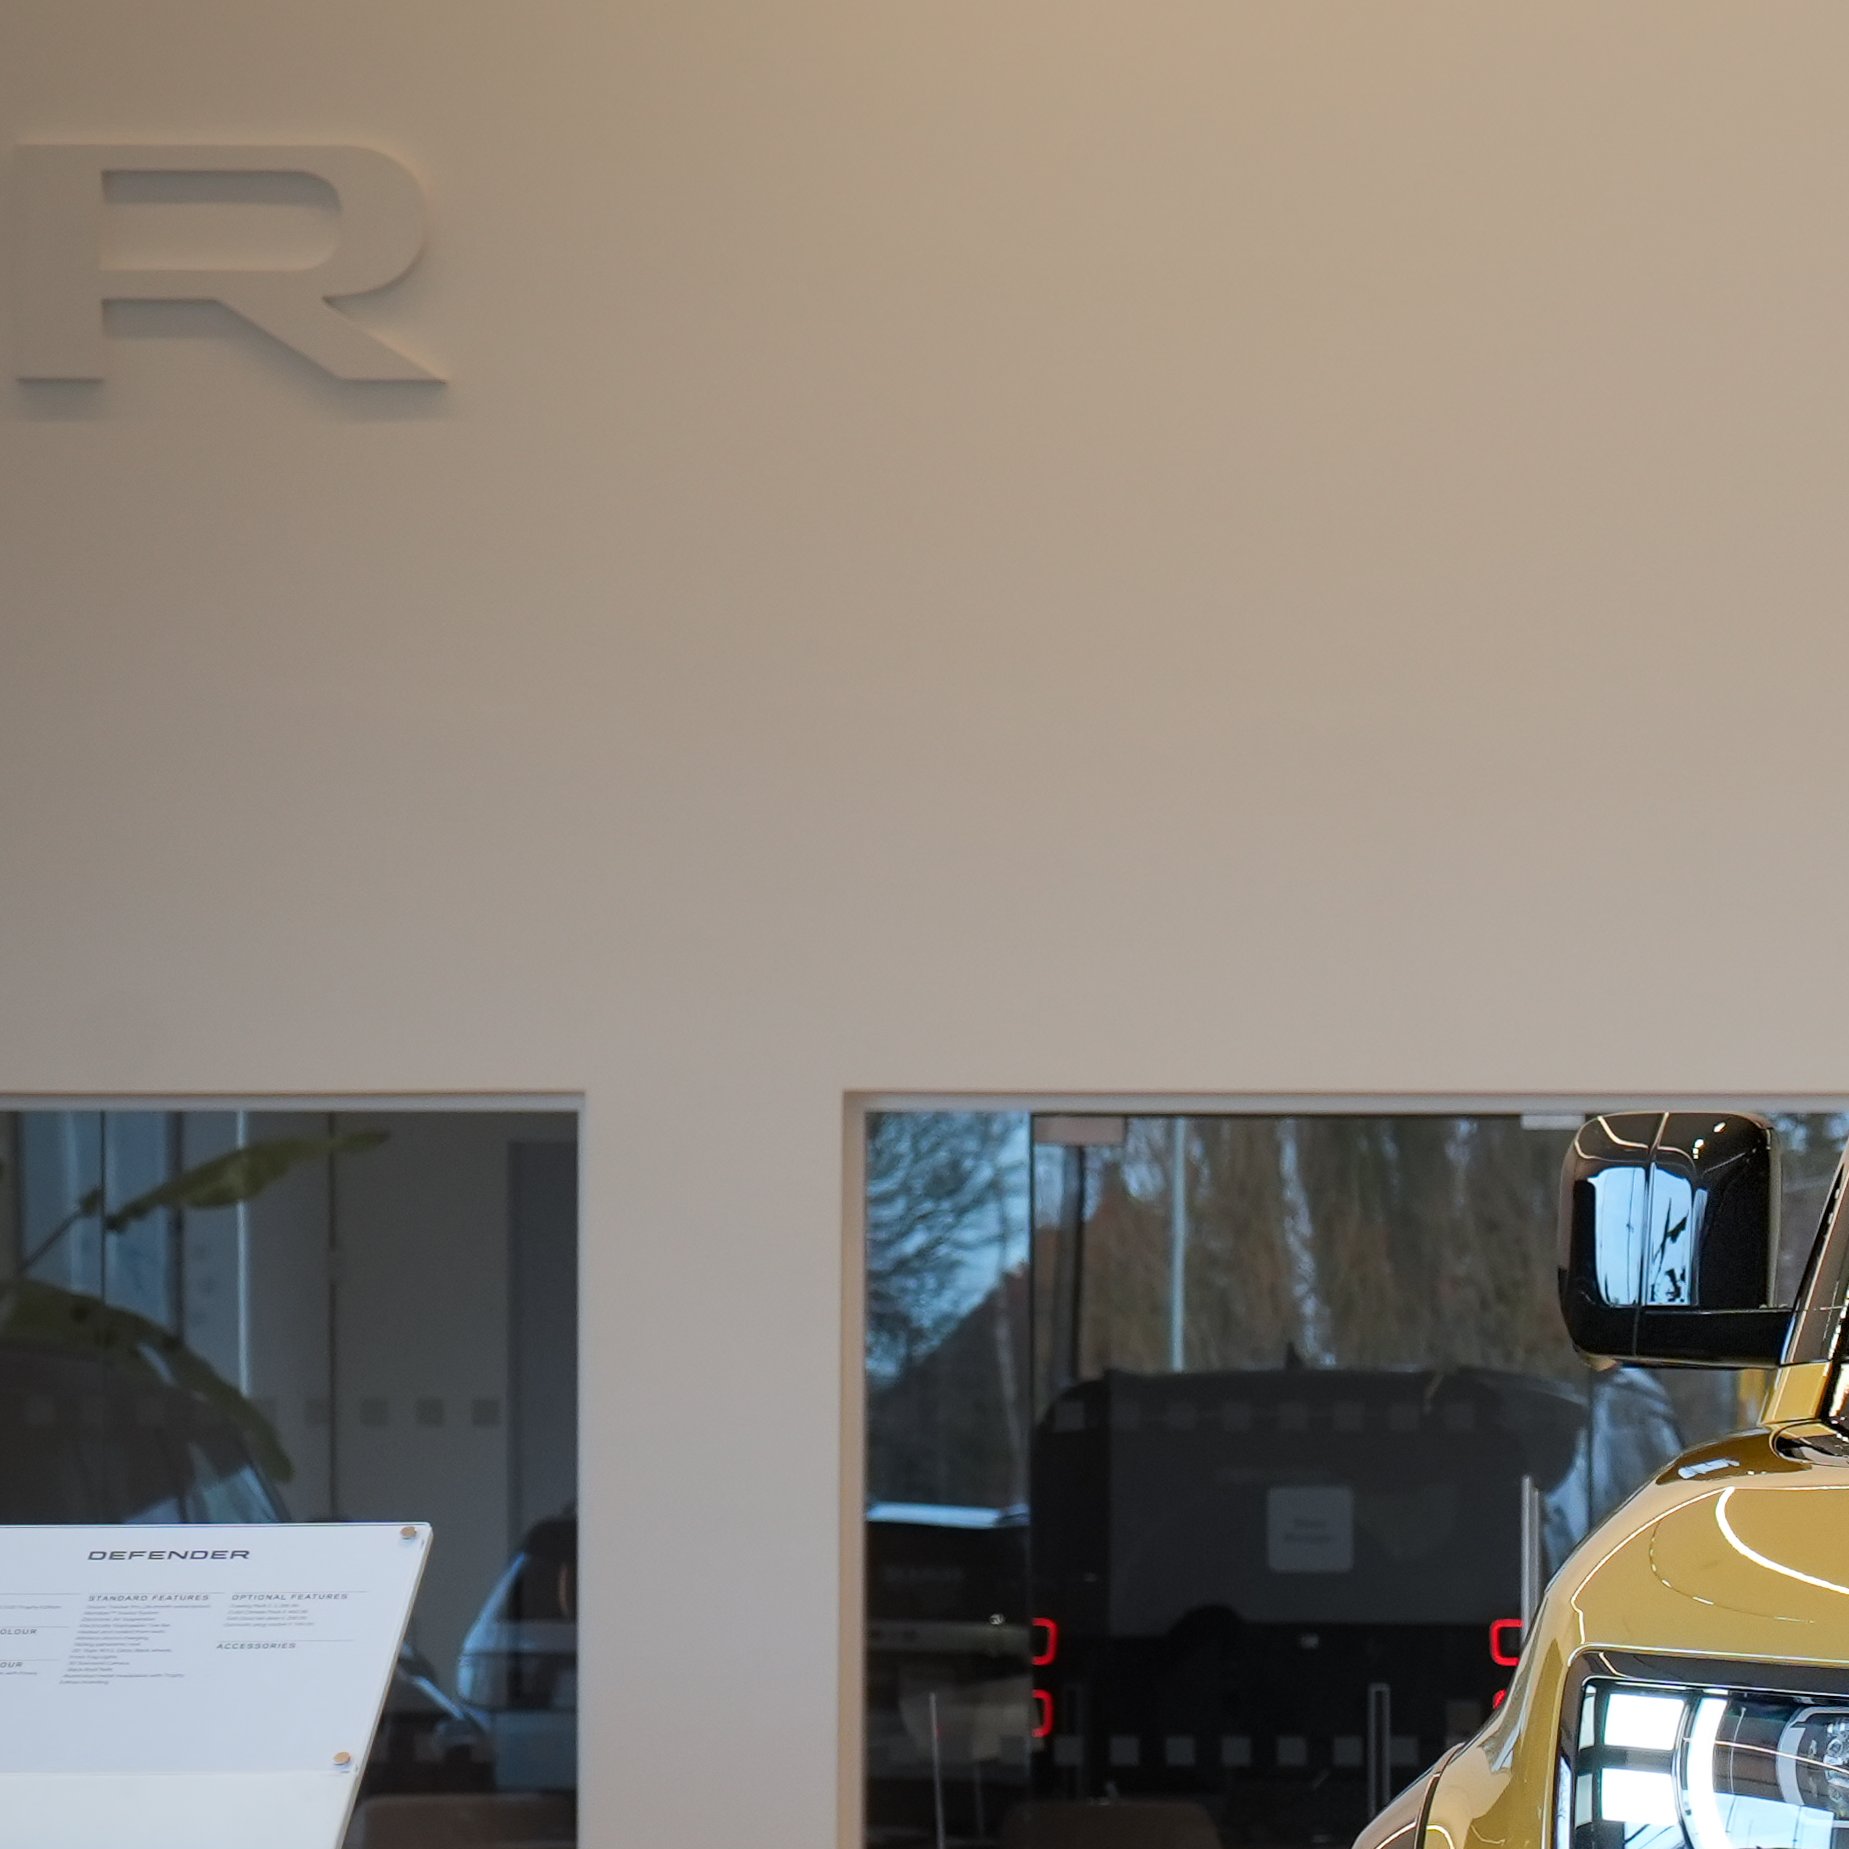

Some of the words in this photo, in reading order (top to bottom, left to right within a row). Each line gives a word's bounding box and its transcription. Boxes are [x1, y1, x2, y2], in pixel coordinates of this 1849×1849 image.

[14, 142, 448, 384] R
[87, 1550, 251, 1561] DEFENDER
[87, 1594, 149, 1602] STANDARD
[231, 1593, 287, 1601] OPTIONAL
[216, 1642, 297, 1650] ACCESSORIES
